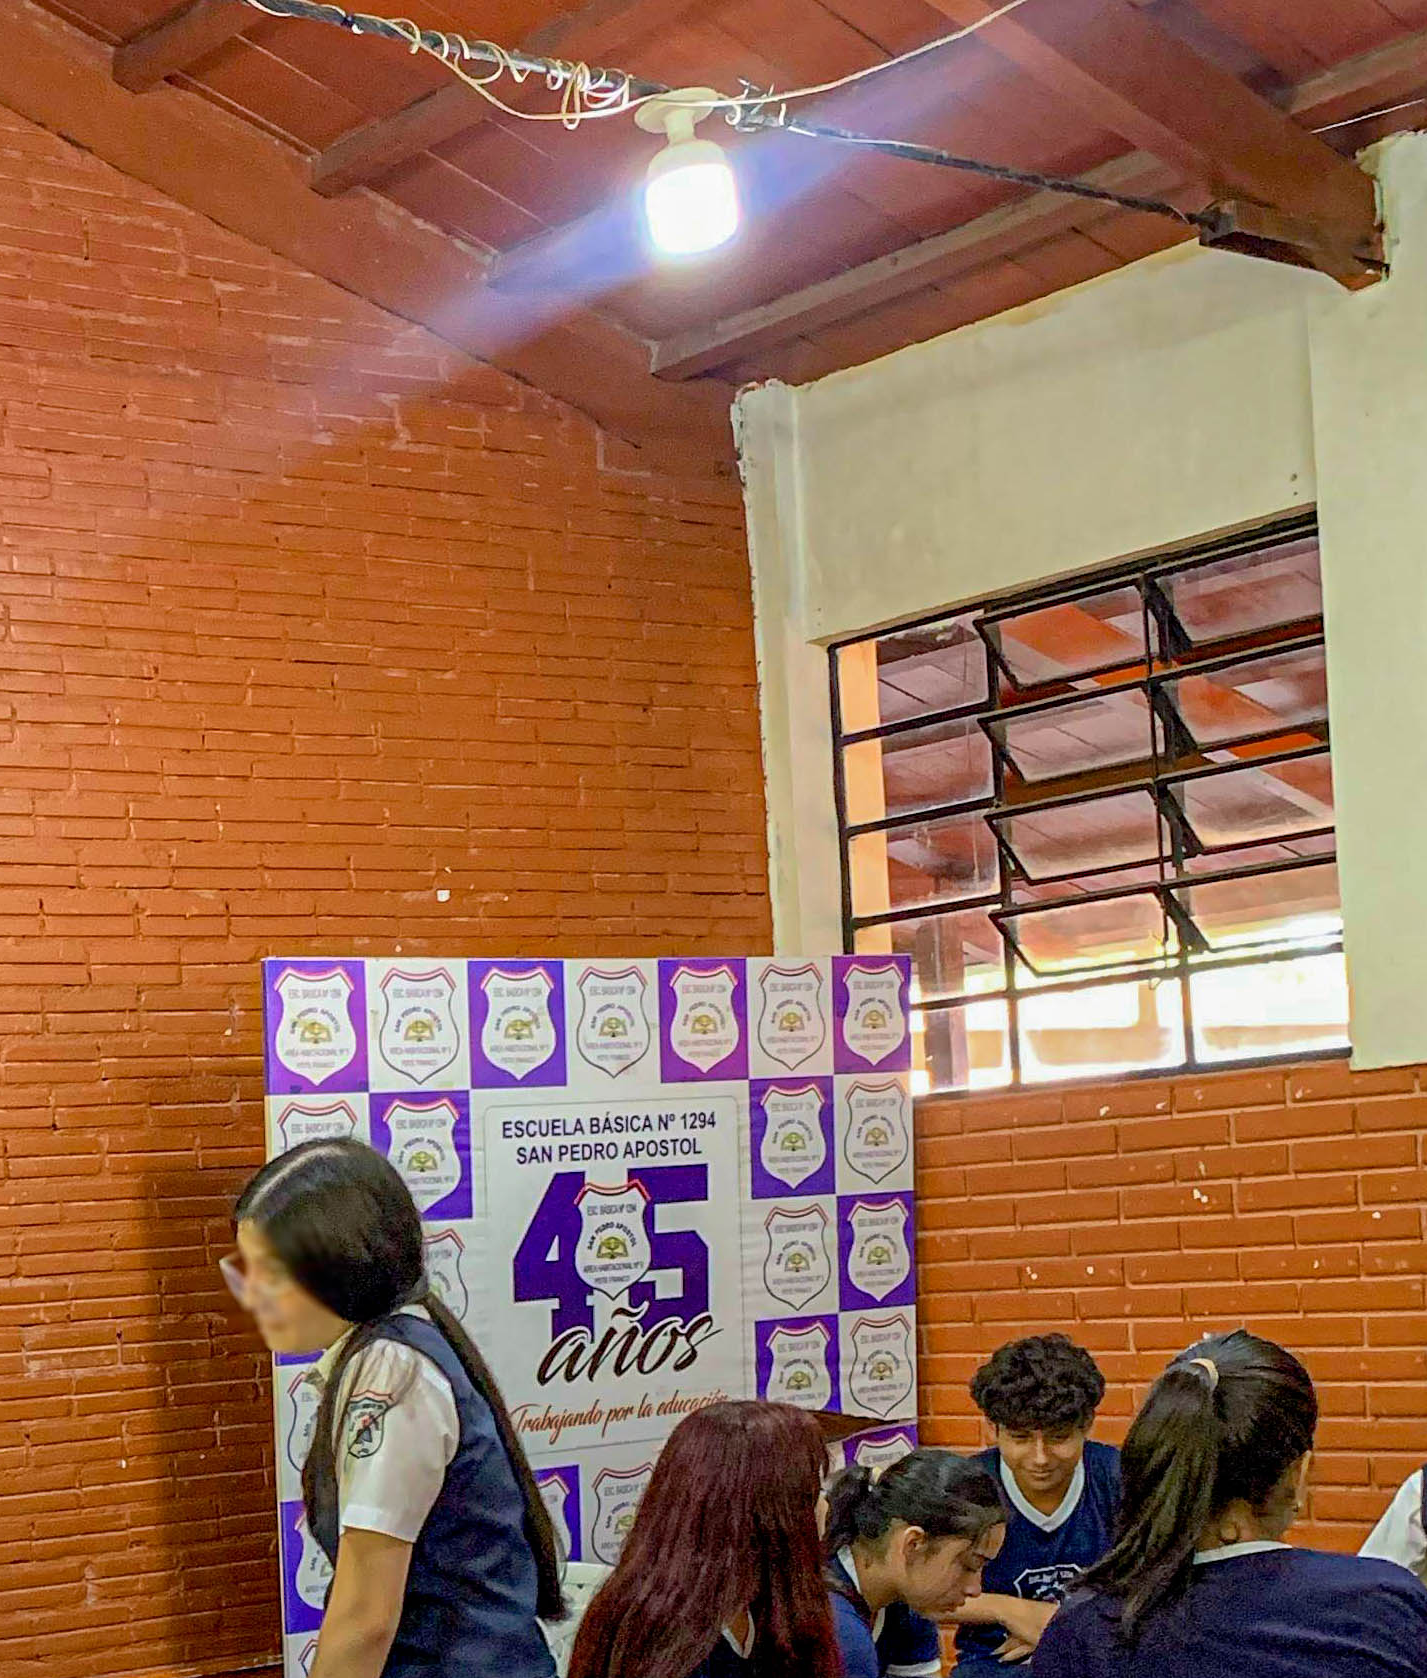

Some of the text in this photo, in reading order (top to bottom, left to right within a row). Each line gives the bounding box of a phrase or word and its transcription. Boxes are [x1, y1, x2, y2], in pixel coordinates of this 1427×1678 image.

[502, 1118, 584, 1139] ESCUELA
[589, 1111, 653, 1134] BÁSICA
[680, 1111, 717, 1130] 1294
[516, 1138, 703, 1165] SAN PEDRO APOSTOL
[513, 1163, 709, 1343] 45
[537, 1307, 724, 1386] años
[510, 1399, 605, 1445] Trabajando
[601, 1406, 634, 1438] por
[637, 1392, 653, 1419] la
